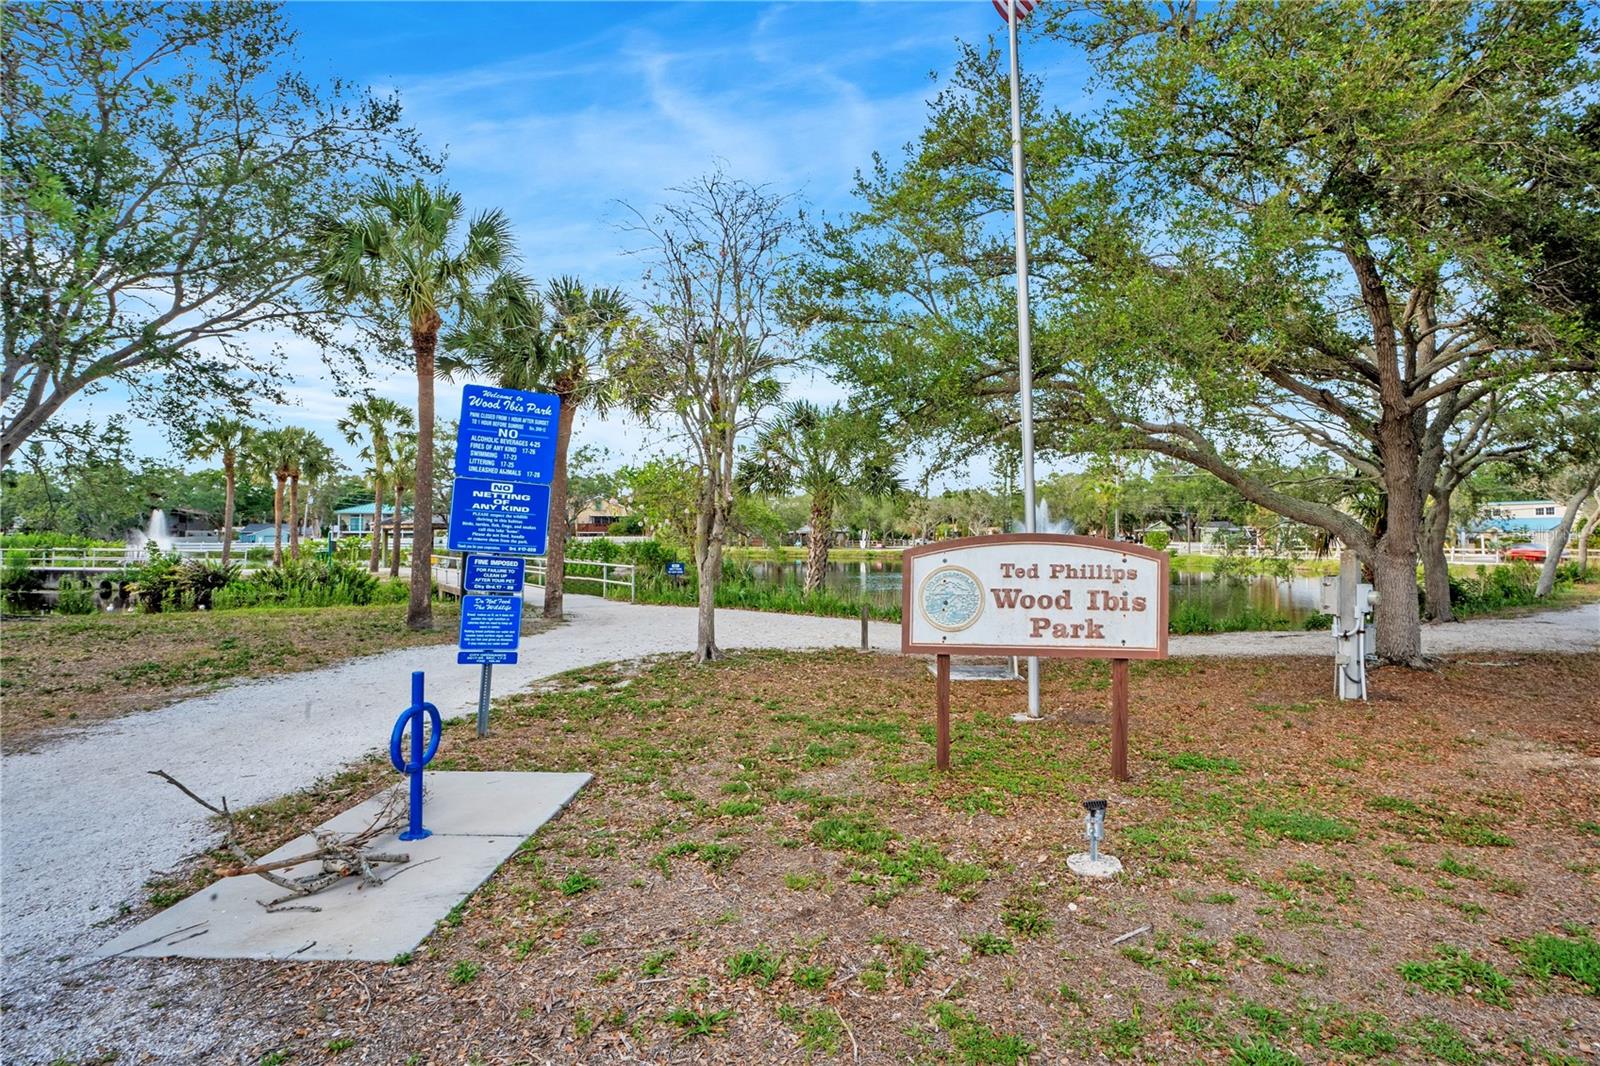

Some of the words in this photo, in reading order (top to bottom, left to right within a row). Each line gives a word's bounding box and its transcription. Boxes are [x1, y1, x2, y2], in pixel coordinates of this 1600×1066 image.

[468, 396, 501, 409] Wood
[503, 400, 524, 412] Ibis
[526, 403, 552, 416] Park
[498, 428, 518, 438] NO
[471, 435, 499, 444] ALCOHOLIC
[500, 438, 528, 446] BEVERAGES
[470, 450, 498, 458] SWIMMING
[469, 458, 496, 466] LITTERING
[468, 466, 499, 474] UNLEASHED
[499, 468, 522, 476] ANIMALS
[472, 490, 530, 501] NETTING
[1000, 563, 1040, 579] Ted
[1049, 564, 1138, 584] Phillips
[991, 588, 1073, 610] Wood
[1087, 590, 1147, 612] Ibis
[1030, 618, 1106, 639] Park
